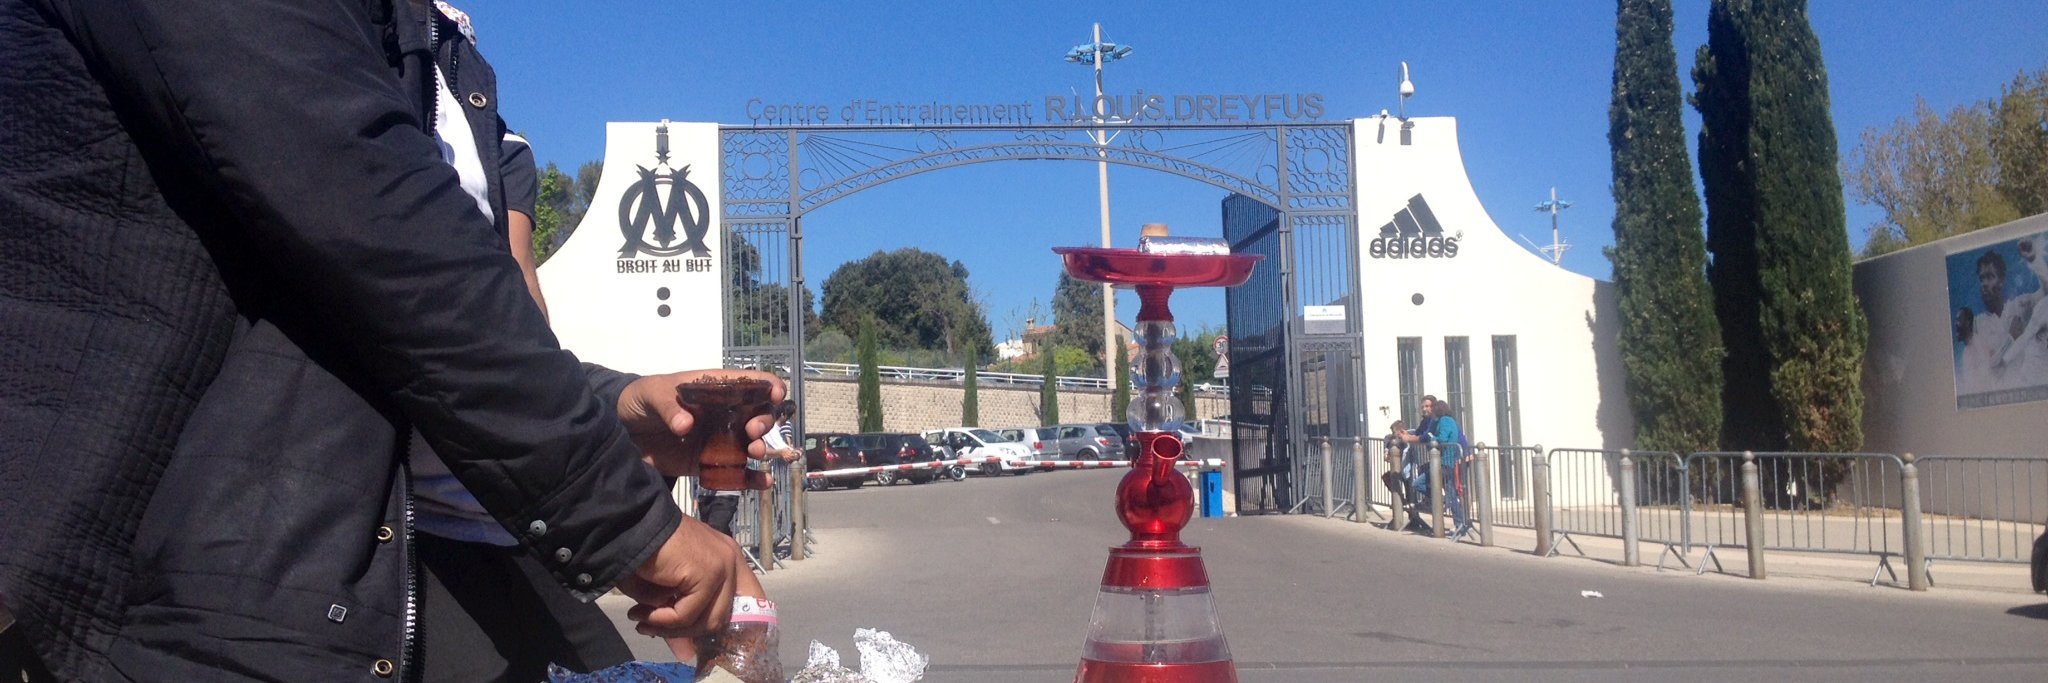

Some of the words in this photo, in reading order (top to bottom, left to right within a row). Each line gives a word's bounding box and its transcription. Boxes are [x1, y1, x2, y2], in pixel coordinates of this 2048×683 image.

[746, 98, 829, 121] Centre
[1369, 234, 1459, 259] adidas
[617, 259, 657, 273] DROIT
[662, 259, 681, 273] AU
[686, 259, 712, 272] BUT
